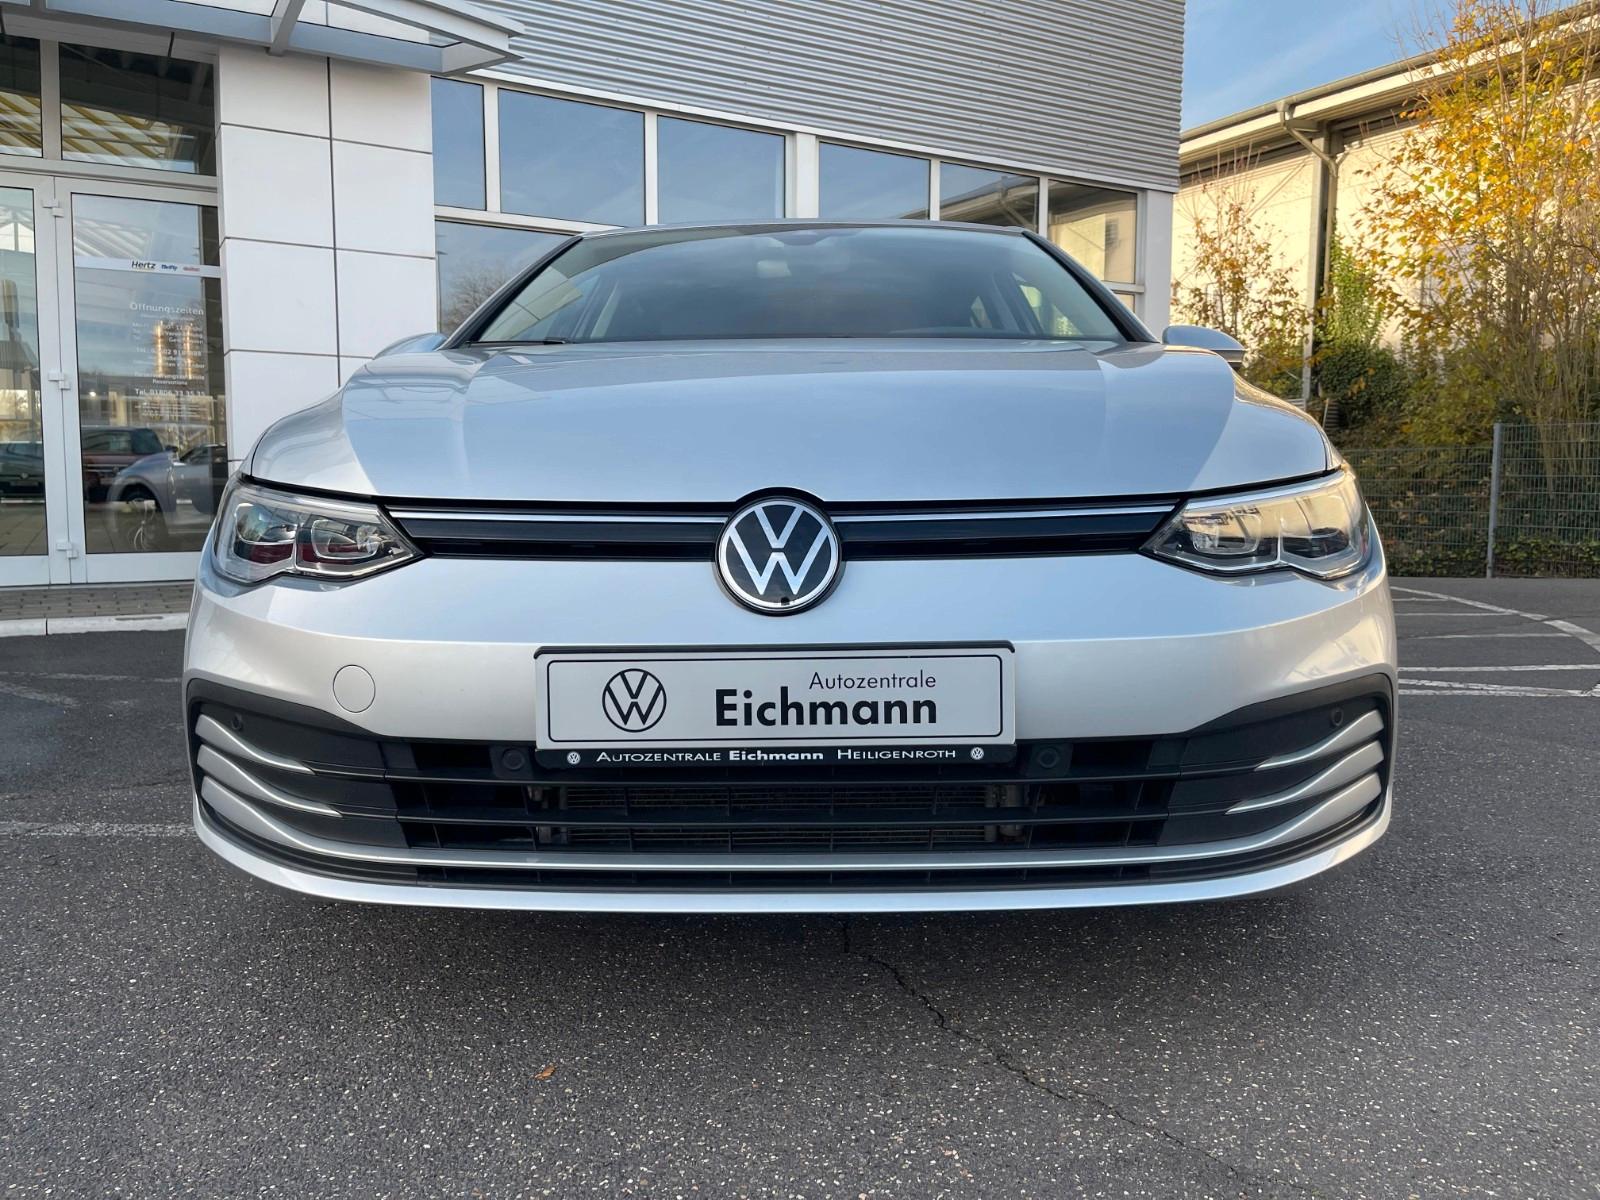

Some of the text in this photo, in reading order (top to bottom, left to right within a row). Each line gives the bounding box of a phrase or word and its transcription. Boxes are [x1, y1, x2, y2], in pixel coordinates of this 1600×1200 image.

[131, 260, 156, 270] Hertz
[809, 670, 937, 690] Autozentrale
[715, 686, 937, 727] Eichmann
[596, 751, 721, 762] AUTOZENTRALE
[729, 750, 824, 761] Eichmann
[837, 748, 956, 760] HEILIGENROTH
